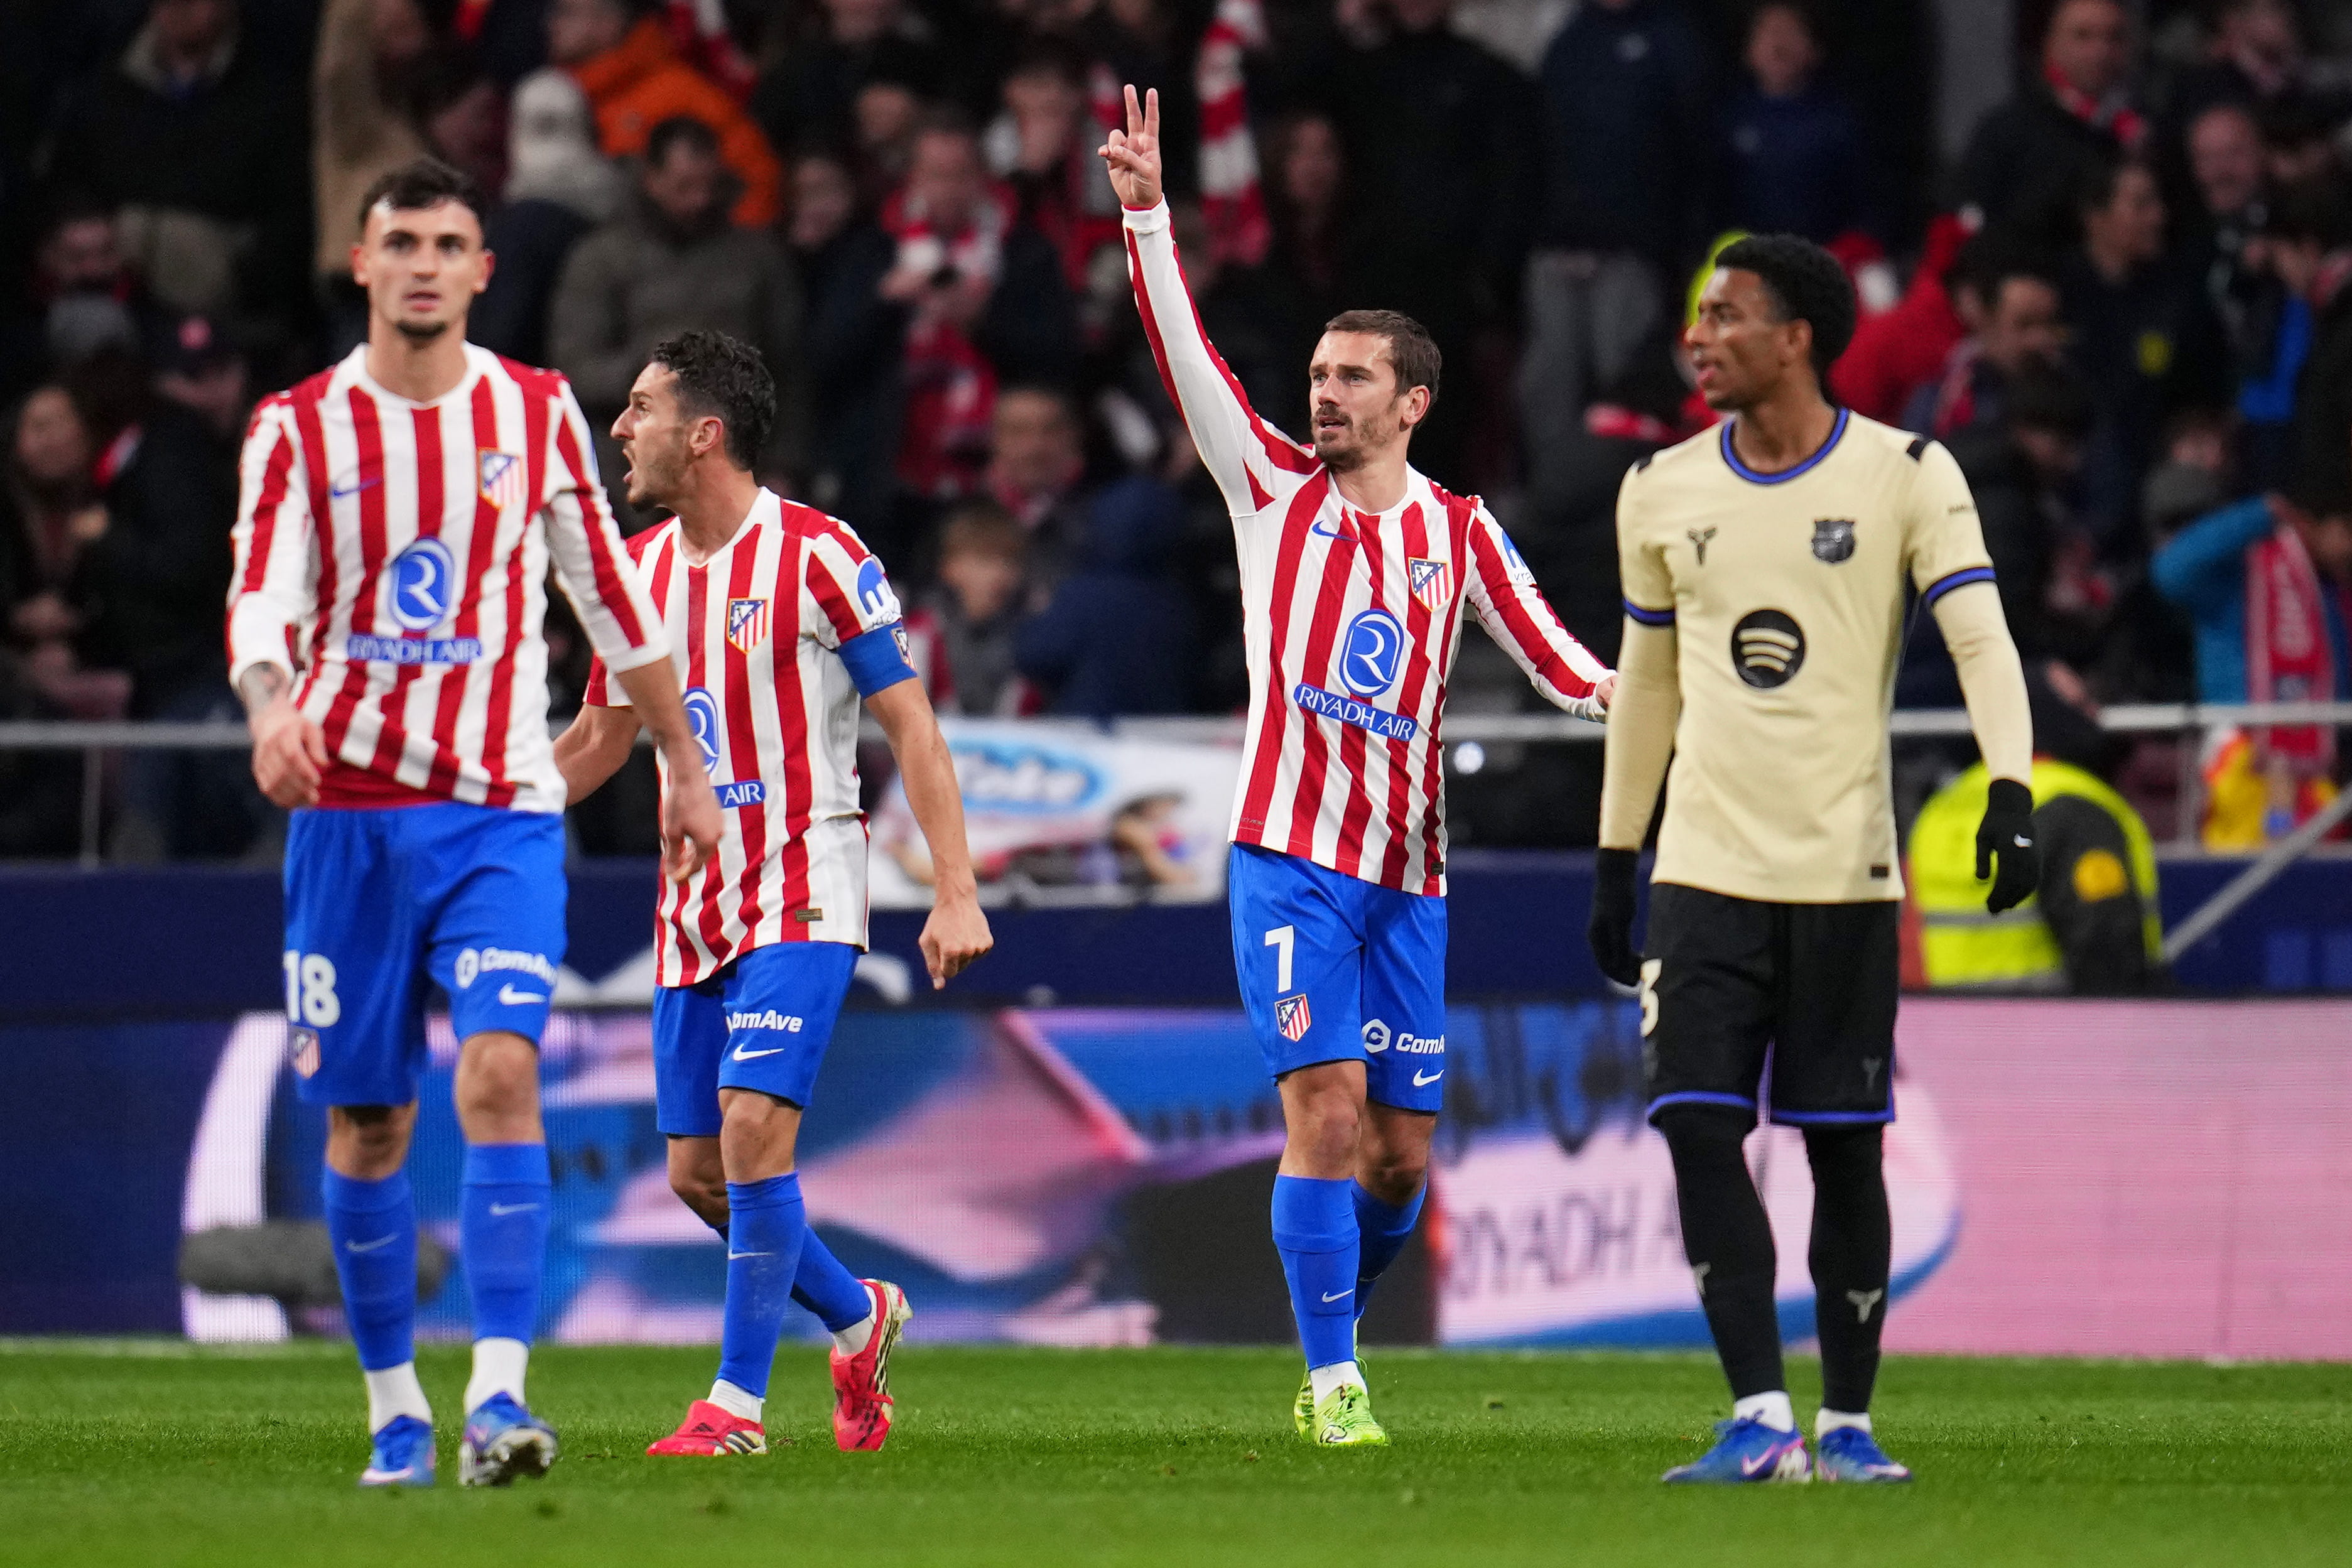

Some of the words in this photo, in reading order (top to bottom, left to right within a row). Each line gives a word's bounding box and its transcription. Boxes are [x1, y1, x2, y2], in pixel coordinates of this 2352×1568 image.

[1298, 686, 1377, 729] RIYADH
[1377, 715, 1413, 740] AIR
[723, 782, 762, 806] AIR
[282, 949, 341, 1028] 18
[1264, 924, 1295, 994] 7
